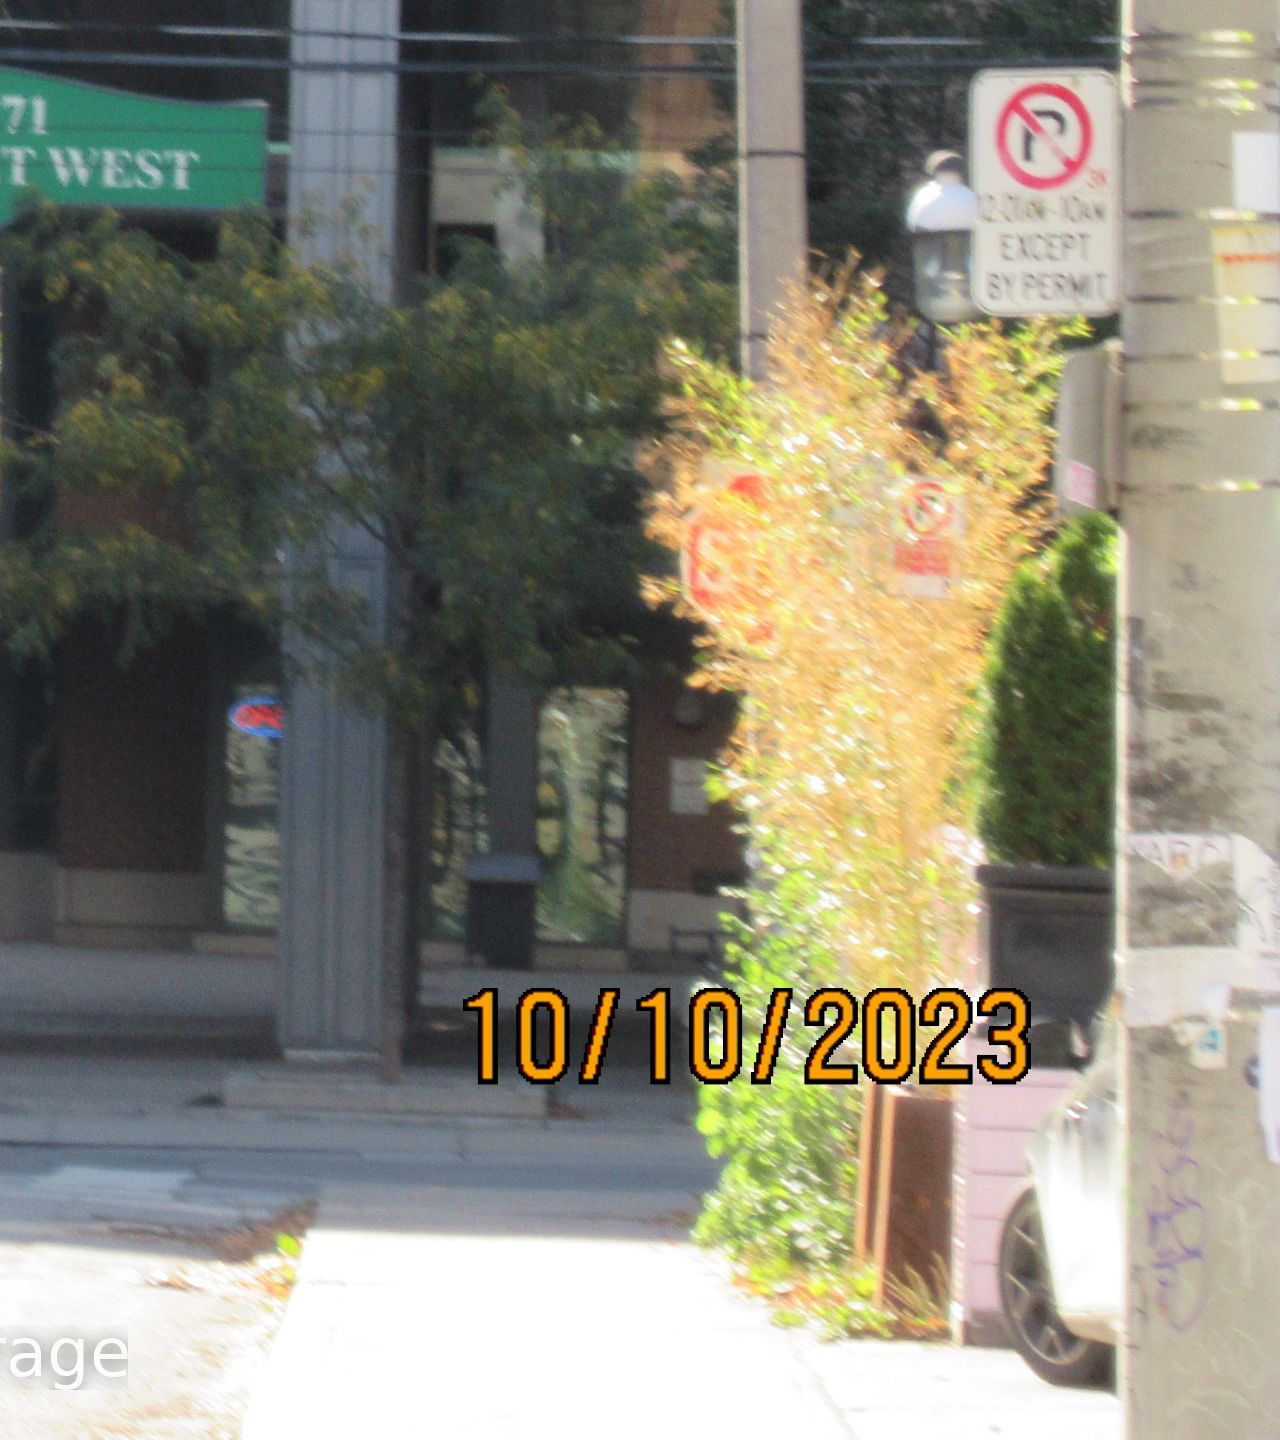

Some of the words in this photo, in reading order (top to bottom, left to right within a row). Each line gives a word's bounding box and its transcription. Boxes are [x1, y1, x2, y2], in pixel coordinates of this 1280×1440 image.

[48, 147, 201, 191] WEST
[999, 232, 1091, 261] EXCEPT
[985, 272, 1013, 301] BY
[1021, 272, 1109, 302] PERMIT
